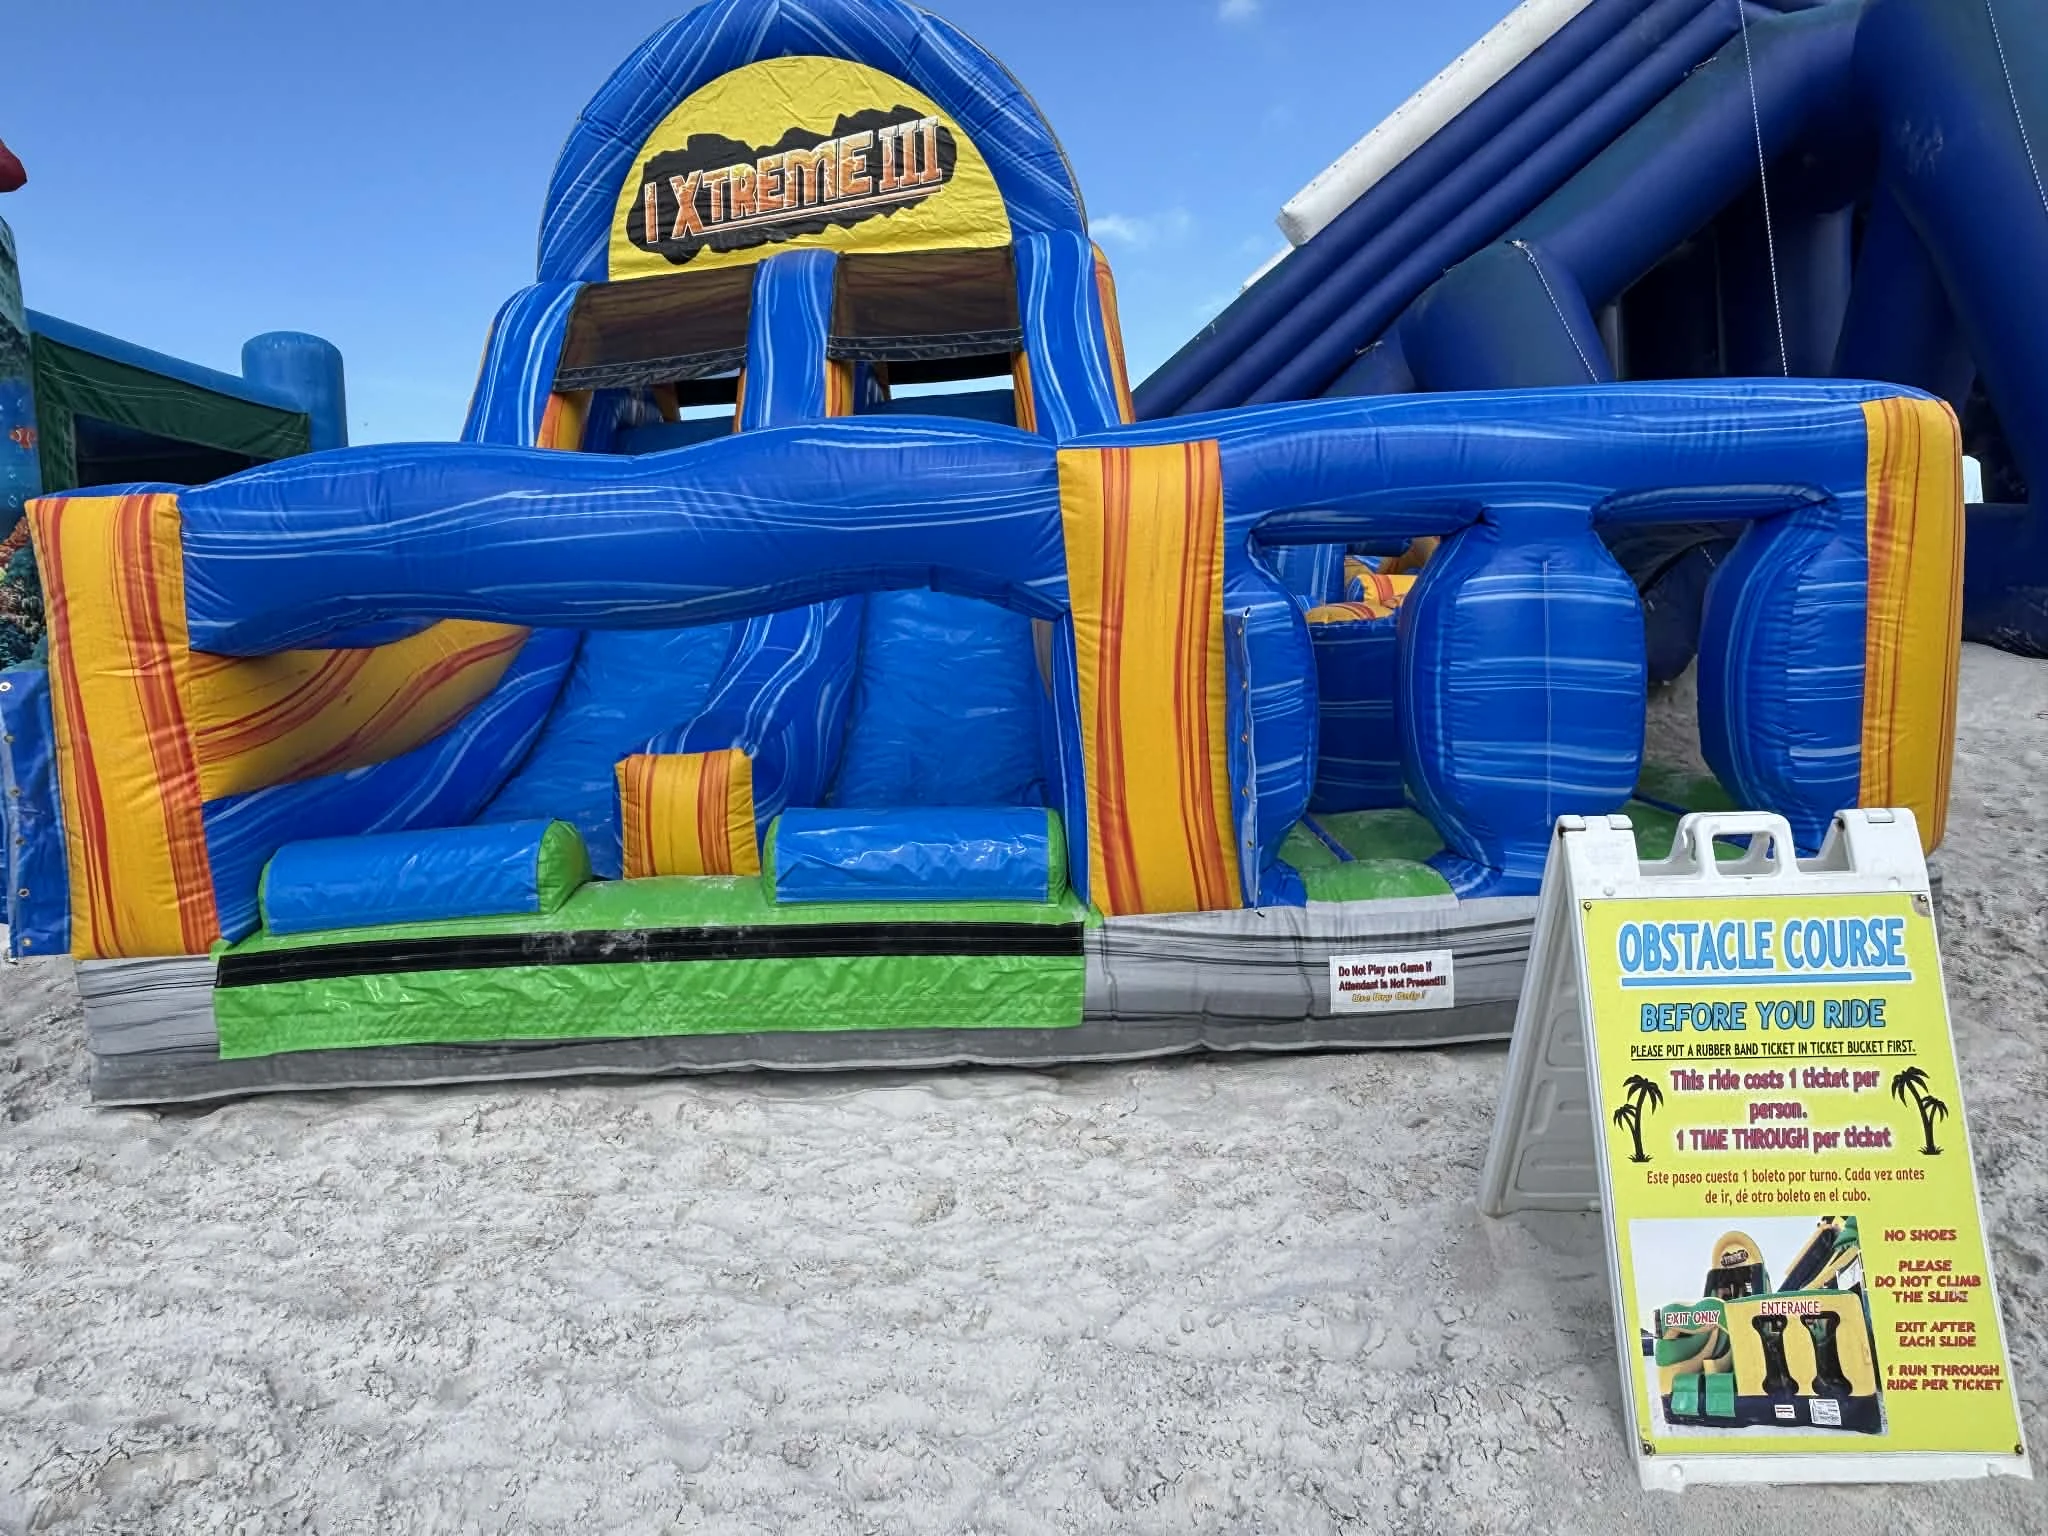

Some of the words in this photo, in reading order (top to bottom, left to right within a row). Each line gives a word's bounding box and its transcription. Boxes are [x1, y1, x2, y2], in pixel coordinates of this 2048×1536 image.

[669, 130, 873, 240] XTREME
[878, 116, 943, 193] III
[1618, 921, 1774, 973] OBSTACLE
[1783, 918, 1906, 969] COURSE
[1338, 966, 1350, 977] Do
[1352, 965, 1366, 976] Not
[1368, 964, 1385, 977] Play
[1388, 965, 1398, 975] on
[1400, 961, 1424, 973] Game
[1339, 979, 1379, 991] Attendant
[1390, 978, 1404, 989] Not
[1640, 1001, 1748, 1032] BEFORE
[1755, 1000, 1815, 1030] YOU
[1823, 998, 1887, 1029] RIDE
[1630, 1044, 1664, 1058] PLEASE
[1666, 1044, 1685, 1057] PUT
[1687, 1043, 1694, 1057] A
[1696, 1043, 1731, 1057] RUBBER
[1734, 1042, 1759, 1056] BAND
[1761, 1042, 1795, 1055] TICKET
[1798, 1042, 1808, 1054] IN
[1810, 1041, 1845, 1054] TICKET
[1847, 1040, 1884, 1054] BUCKET
[1887, 1040, 1916, 1053] FIRST.
[1670, 1068, 1704, 1091] This
[1708, 1068, 1741, 1090] ride
[1744, 1069, 1784, 1089] costs
[1789, 1068, 1797, 1089] 1
[1802, 1066, 1849, 1088] ticket
[1853, 1071, 1880, 1092] per
[1749, 1102, 1807, 1124] person.
[1676, 1129, 1684, 1151] 1
[1689, 1128, 1728, 1150] TIME
[1732, 1128, 1809, 1150] THROUGH
[1812, 1131, 1841, 1153] per
[1844, 1125, 1892, 1148] ticket
[1647, 1170, 1669, 1184] Este
[1672, 1172, 1702, 1188] paseo
[1705, 1170, 1739, 1183] cuesta
[1743, 1169, 1748, 1183] 1
[1752, 1168, 1785, 1183] boleto
[1788, 1171, 1806, 1184] por
[1809, 1169, 1842, 1182] turno.
[1845, 1167, 1871, 1181] Cada
[1874, 1169, 1893, 1180] vez
[1896, 1167, 1925, 1180] antes
[1705, 1189, 1718, 1203] de
[1720, 1189, 1733, 1206] ir,
[1735, 1188, 1748, 1203] dé
[1751, 1190, 1774, 1203] otro
[1777, 1188, 1810, 1202] boleto
[1813, 1190, 1826, 1201] en
[1829, 1187, 1839, 1201] el
[1842, 1187, 1871, 1201] cubo.
[1884, 1229, 1906, 1242] NO
[1910, 1229, 1957, 1241] SHOES
[1898, 1259, 1952, 1272] PLEASE
[1875, 1275, 1896, 1287] DO
[1900, 1275, 1932, 1287] NOT
[1936, 1275, 1982, 1287] CLIMB
[1892, 1291, 1924, 1303] THE
[1761, 1301, 1820, 1315] ENTERANCE
[1665, 1312, 1690, 1325] EXIT
[1694, 1310, 1720, 1324] ONLY
[1895, 1321, 1927, 1333] EXIT
[1930, 1321, 1976, 1333] AFTER
[1899, 1336, 1936, 1347] EACH
[1939, 1336, 1976, 1347] SLIDE
[1887, 1364, 1893, 1376] 1
[1899, 1365, 1927, 1376] RUN
[1932, 1364, 2000, 1376] THROUGH
[1886, 1379, 1918, 1391] RIDE
[1922, 1379, 1949, 1391] PER
[1952, 1379, 2004, 1391] TICKET
